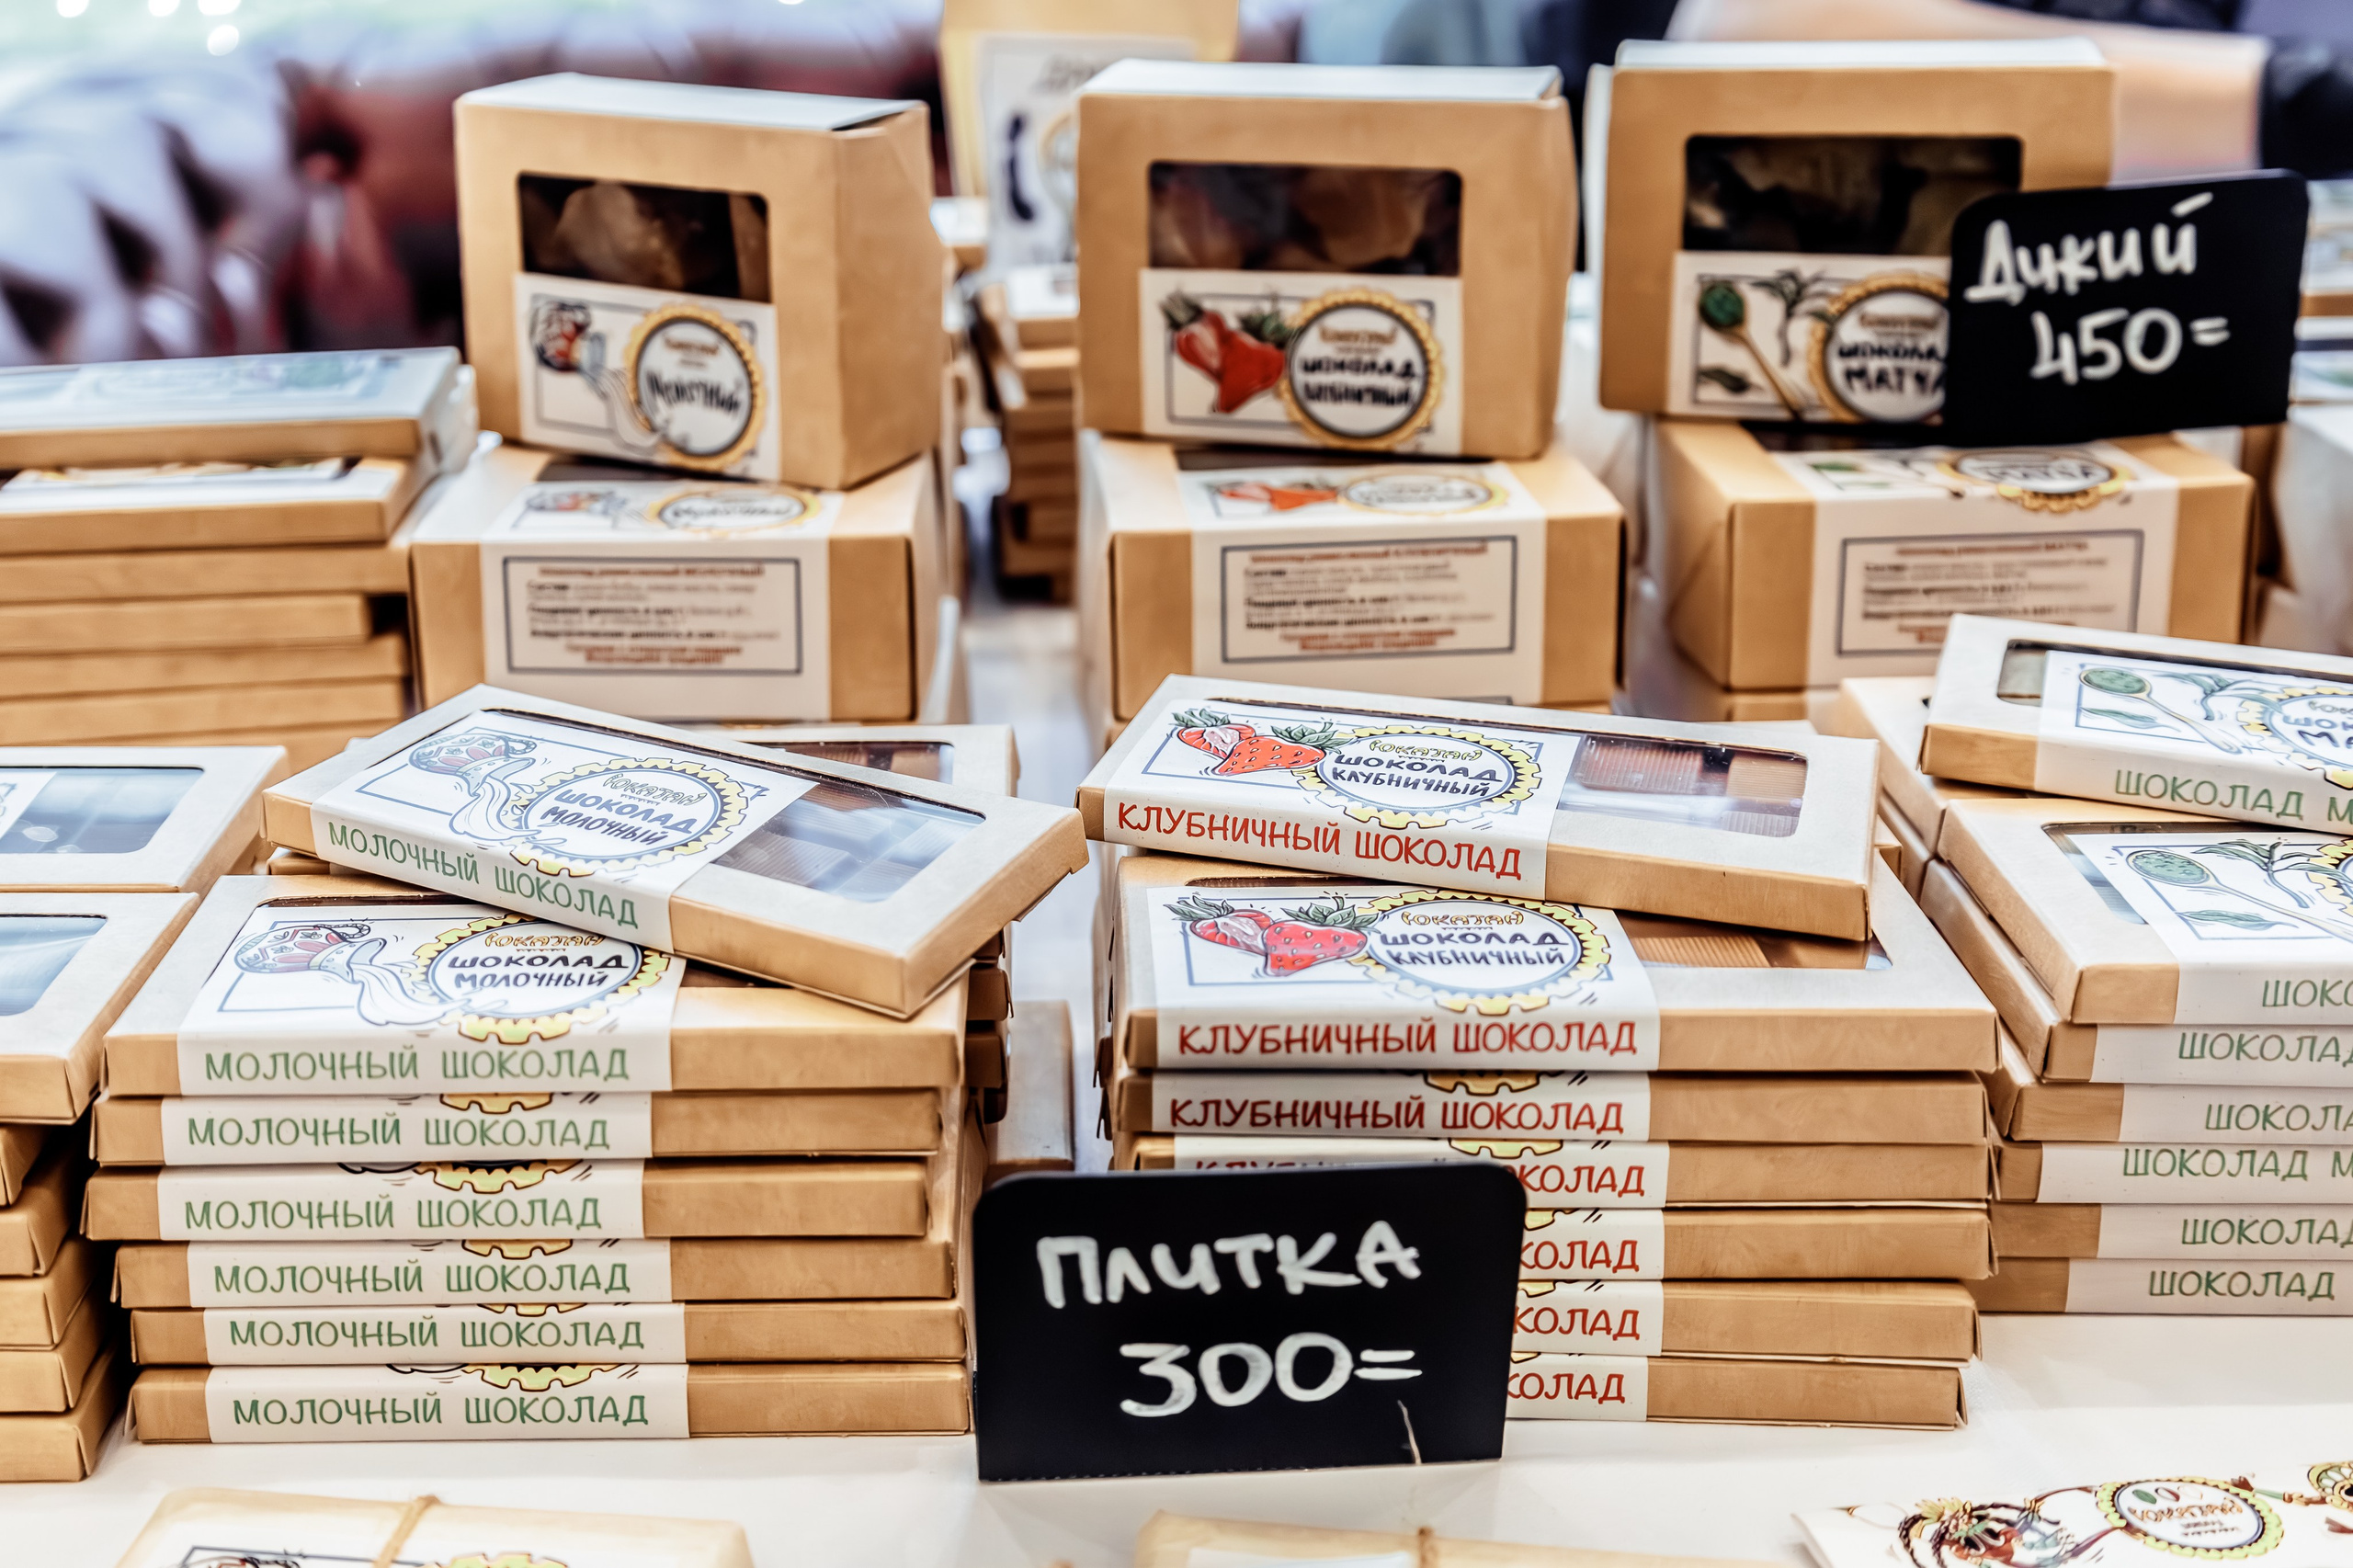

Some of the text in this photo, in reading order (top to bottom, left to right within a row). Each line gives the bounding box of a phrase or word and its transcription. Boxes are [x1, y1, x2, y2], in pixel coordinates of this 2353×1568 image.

[2029, 307, 2232, 385] 450=
[1332, 767, 1491, 797] КЛУБНИЧНЫЙ
[1335, 755, 1503, 783] ШОКОЛАД
[2115, 768, 2305, 820] ШОКОЛАД
[540, 806, 669, 846] МОЛОЧНЫЙ
[554, 789, 698, 835] ШОКОЛАД
[1119, 802, 1522, 881] КЛУБНИЧНЫЙ ШОКОЛАД
[328, 820, 639, 930] МОЛОЧНЫЙ ШОКОЛАД
[1380, 932, 1569, 946] ШОКОЛАД
[448, 954, 630, 970] ШОКОЛАД
[1386, 948, 1565, 966] КЛУБНИЧНЫЙ
[454, 971, 609, 988] МОЛОЧНЫЙ
[1179, 1017, 1637, 1057] КЛУБНИЧНЫЙ ШОКОЛАД
[206, 1045, 630, 1082] МОЛОЧНЫЙ ШОКОЛАД
[188, 1112, 610, 1151] МОЛОЧНЫЙ ШОКОЛАД
[1171, 1096, 1624, 1136] КЛУБНИЧНЫЙ ШОКОЛАД
[1507, 1164, 1645, 1199] КОЛАД
[2123, 1148, 2308, 1181] ШОКОЛАД
[186, 1195, 602, 1231] МОЛОЧНЫЙ ШОКОЛАД
[1519, 1240, 1640, 1274] КОЛАД
[214, 1259, 631, 1295] МОЛОЧНЫЙ ШОКОЛАД
[2149, 1270, 2335, 1301] ШОКОЛАД
[230, 1315, 645, 1350] МОЛОЧНЫЙ ШОКОЛАД
[1514, 1307, 1641, 1342] КОЛАД
[1119, 1331, 1423, 1418] 300=
[1506, 1373, 1626, 1405] КОЛАД
[233, 1392, 649, 1427] МОЛОЧНЫЙ ШОКОЛАД
